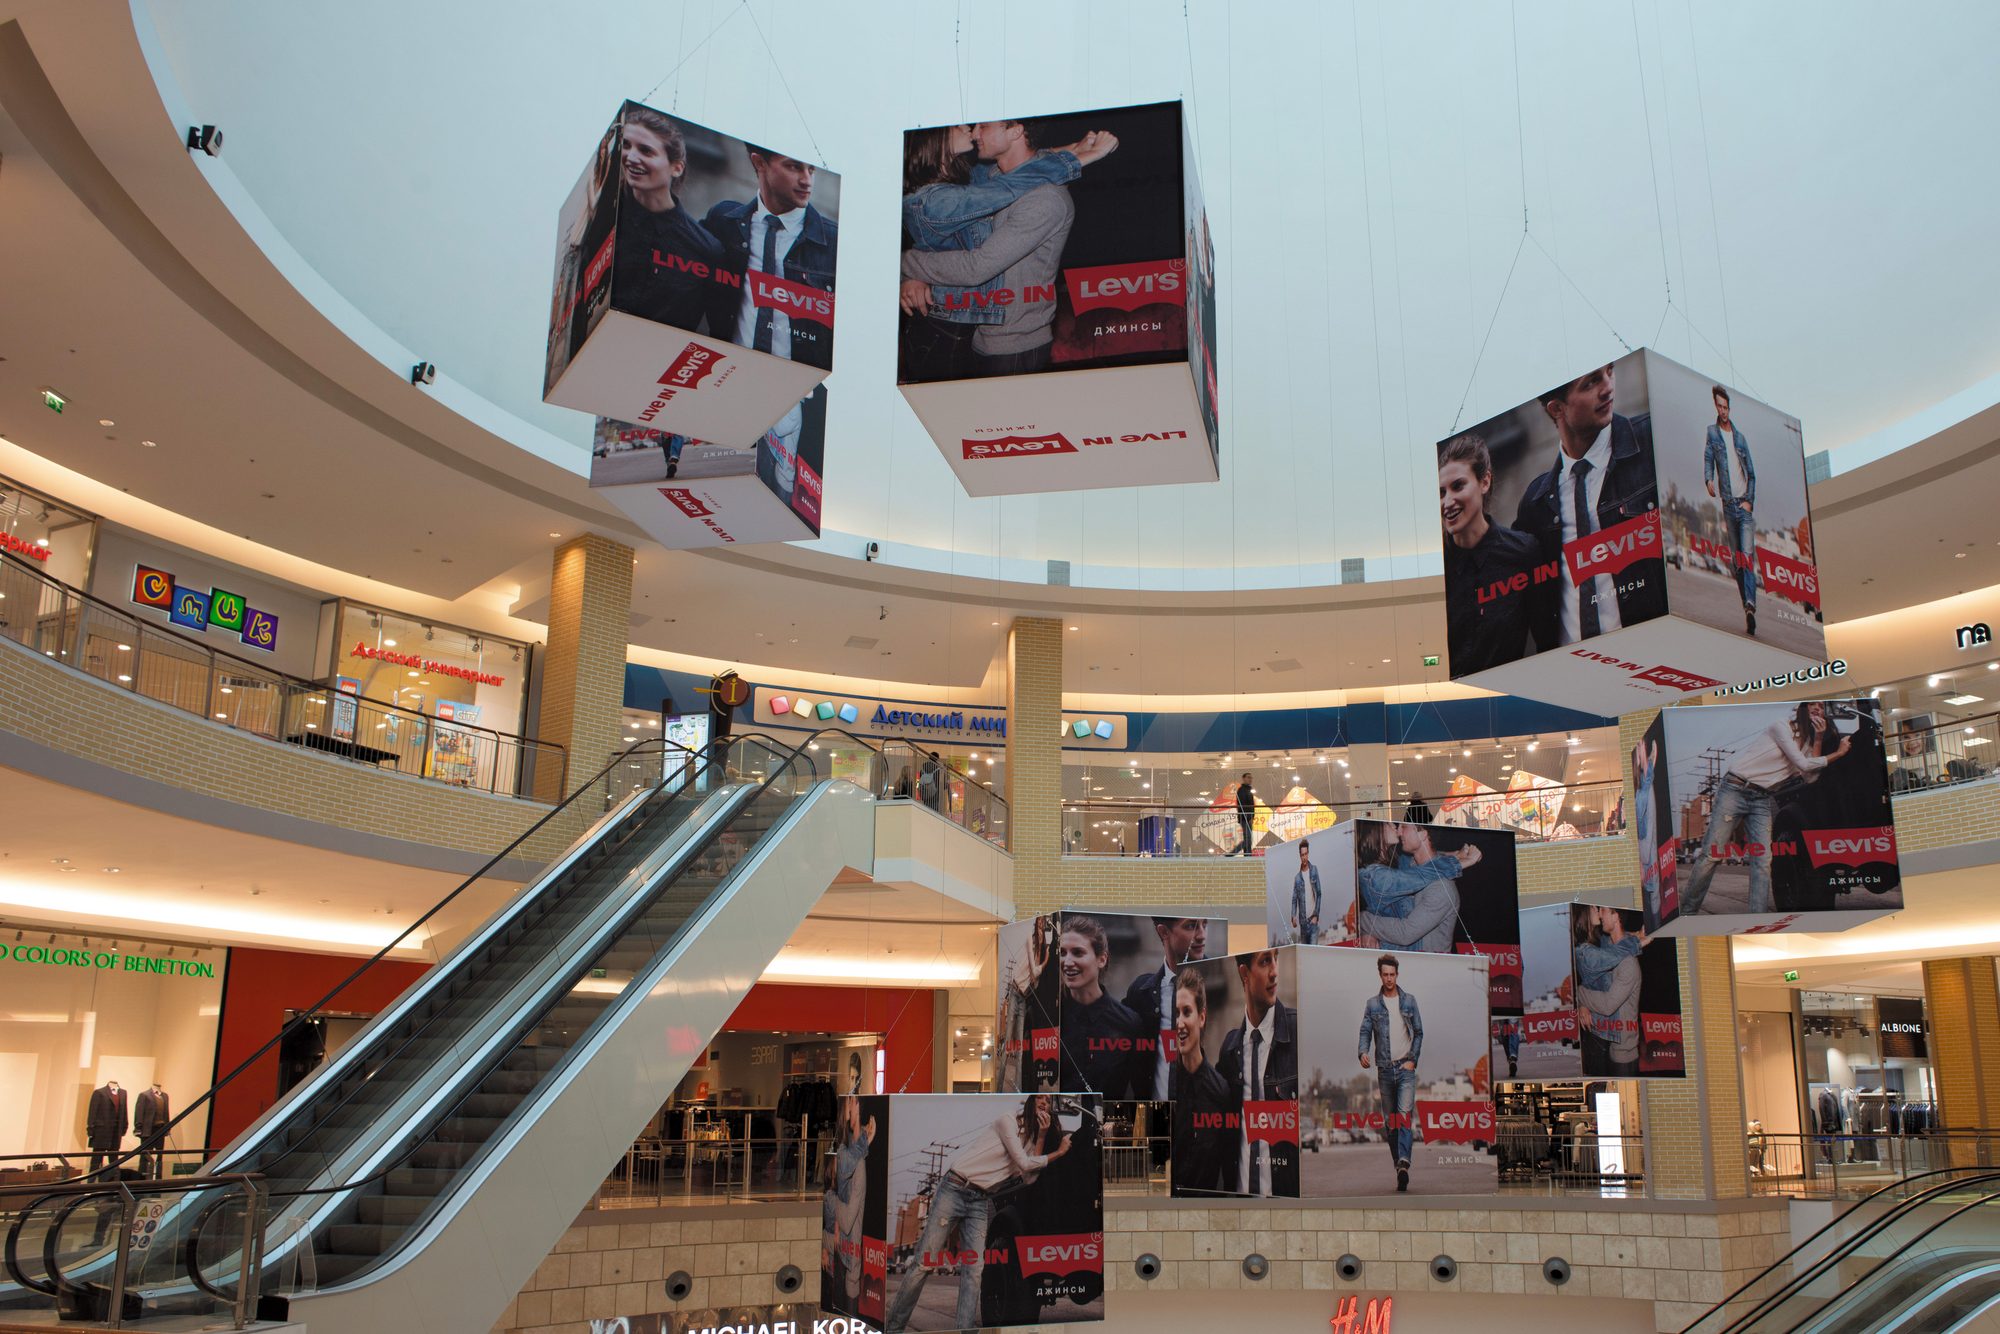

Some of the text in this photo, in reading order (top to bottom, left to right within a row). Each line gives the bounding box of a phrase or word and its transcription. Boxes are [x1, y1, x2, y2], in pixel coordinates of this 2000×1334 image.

[1093, 321, 1162, 337] ДЖИНСЫ
[351, 641, 506, 687] Детский универмаг
[871, 704, 963, 730] Детский
[13, 945, 93, 968] COLORS
[95, 953, 120, 969] OF
[1881, 1022, 1922, 1034] ALBIONE
